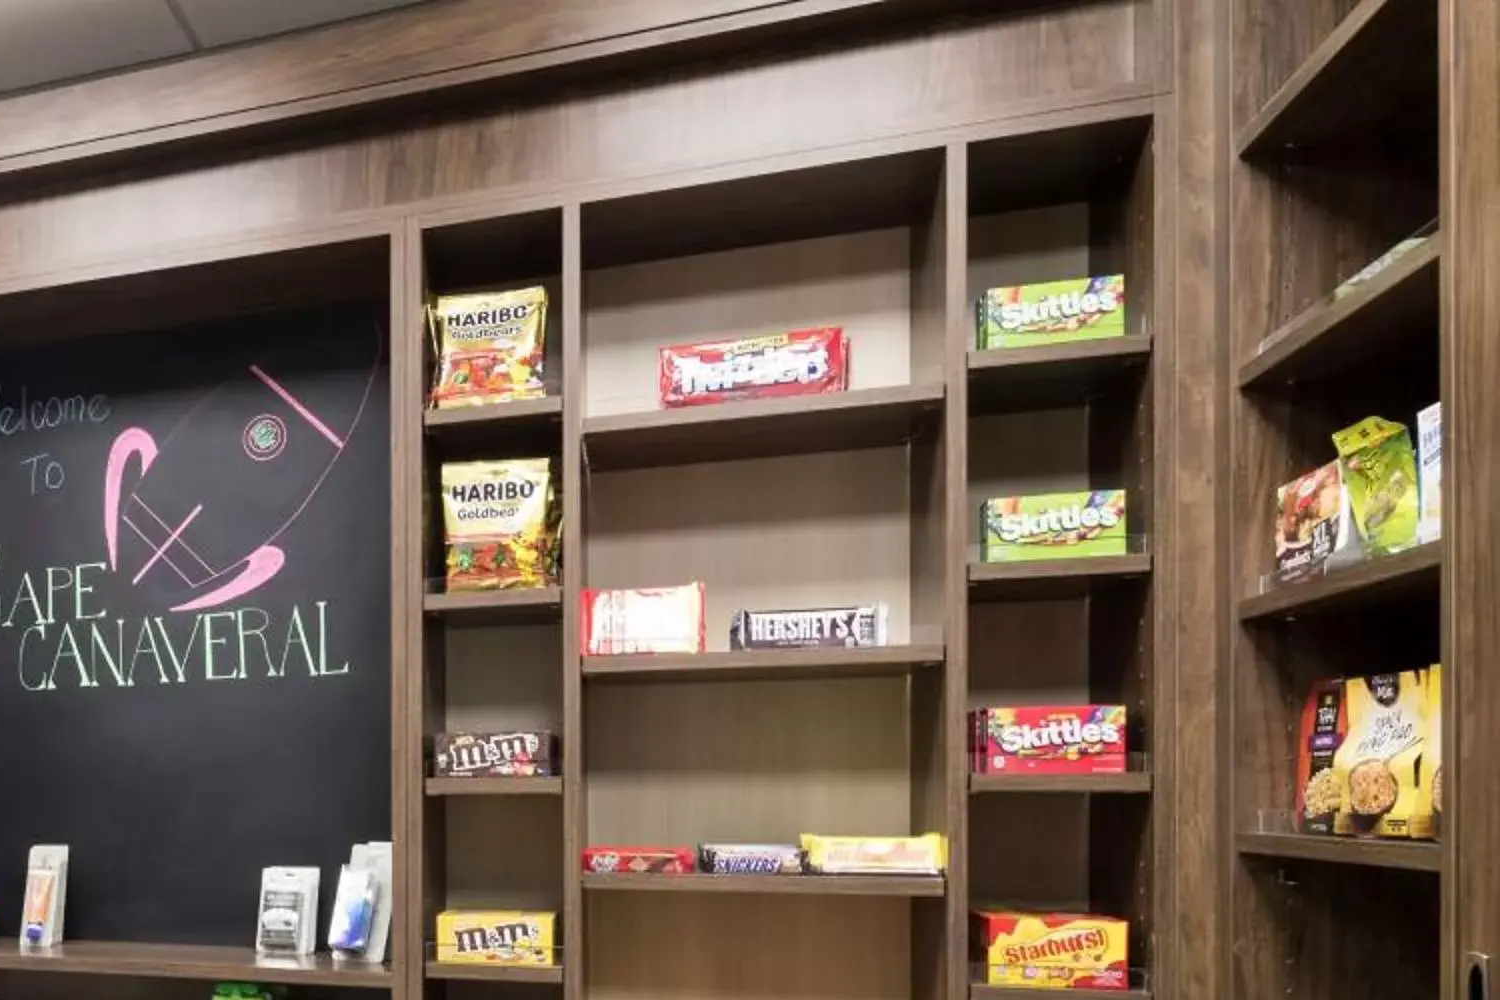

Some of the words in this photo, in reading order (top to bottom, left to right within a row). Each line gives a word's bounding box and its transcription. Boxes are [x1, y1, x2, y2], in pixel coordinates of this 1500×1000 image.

[447, 304, 528, 328] HARIBO
[1000, 291, 1116, 328] Skittles
[451, 480, 535, 503] HARIBO
[999, 506, 1119, 541] Skittles
[750, 613, 849, 641] HERSHEY'S
[18, 600, 351, 692] CANAVERAL
[999, 719, 1120, 754] Skittles
[714, 857, 782, 873] SNICKERS
[1003, 930, 1106, 966] Starburst
